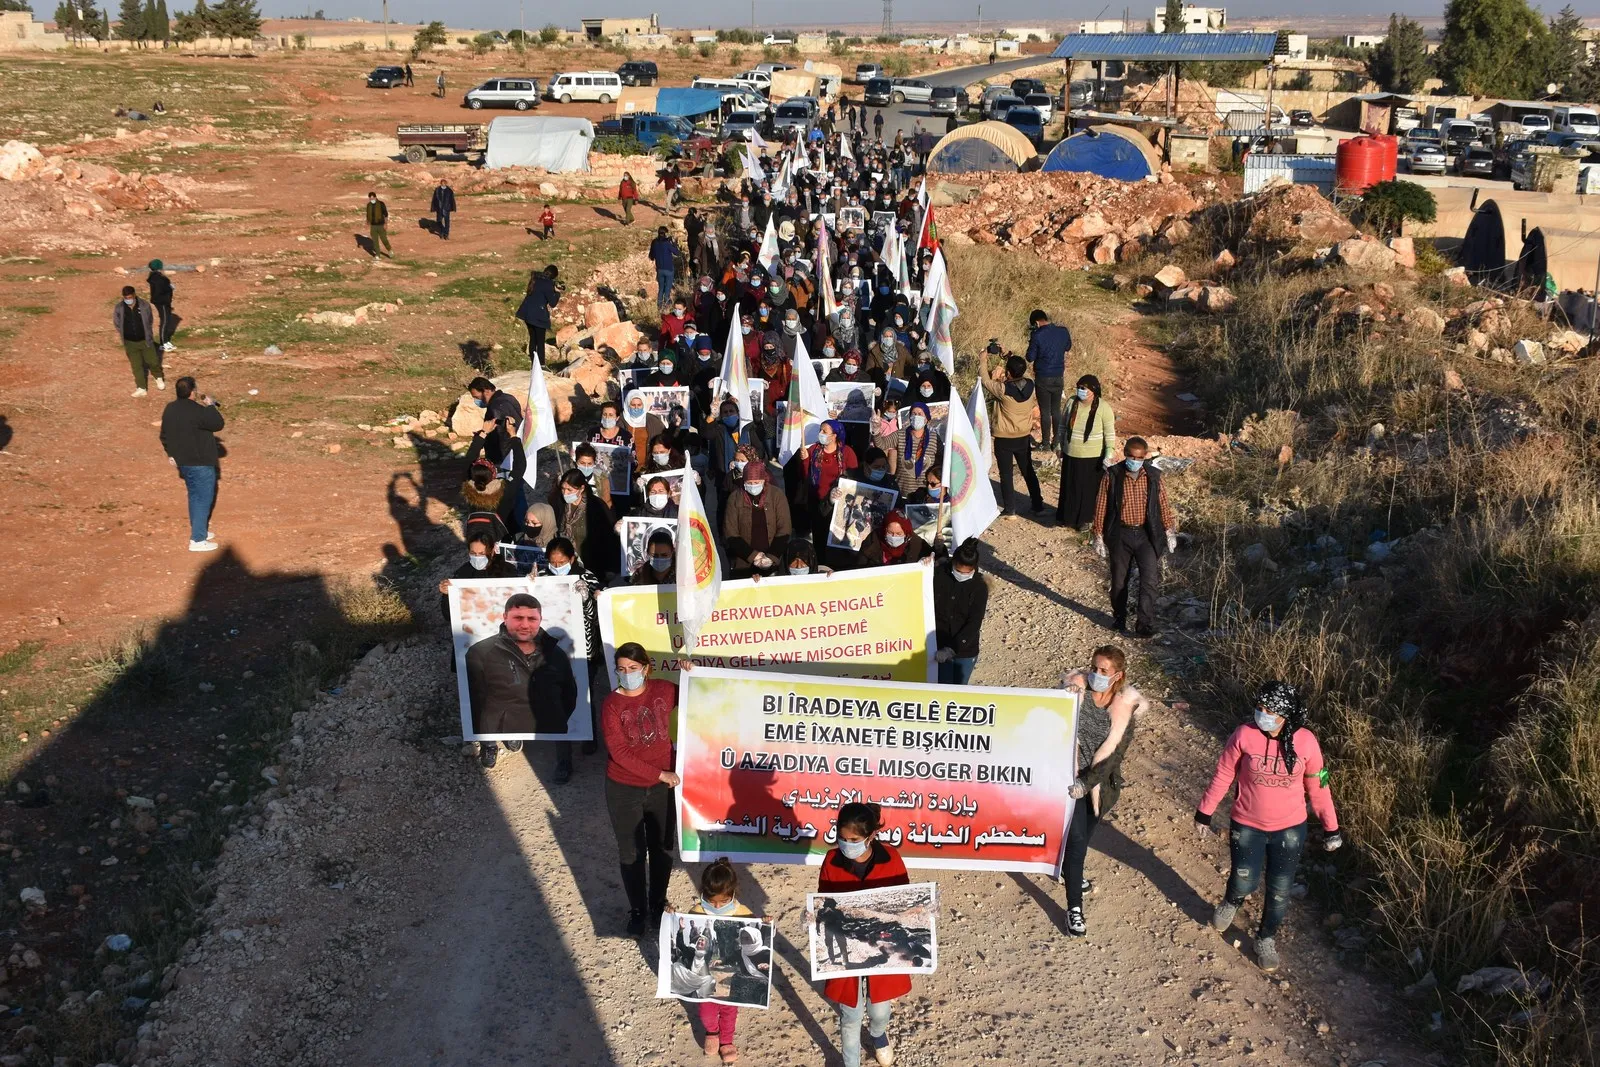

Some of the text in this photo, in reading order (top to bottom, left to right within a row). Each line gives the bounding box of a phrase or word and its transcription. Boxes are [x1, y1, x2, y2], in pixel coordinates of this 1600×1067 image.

[711, 602, 816, 622] BERXWEDANA
[820, 592, 884, 617] ŞENGALÊ
[673, 634, 683, 649] Û
[800, 618, 868, 640] SERDEMÊ
[661, 655, 726, 672] AZDİYA
[729, 652, 766, 668] GELÊ
[769, 651, 803, 666] XWE
[762, 691, 996, 725] BI ÎRADEYA GELÊ ÊZDÎ
[764, 721, 991, 753] EMÊ ÎXANETÊ BIŞKÎNIN
[721, 748, 1032, 784] Û AZADIYA GEL MISOGER BIKIN
[772, 815, 818, 841] حرية
[907, 821, 971, 848] الخيانة
[974, 826, 1046, 850] سنحطم
